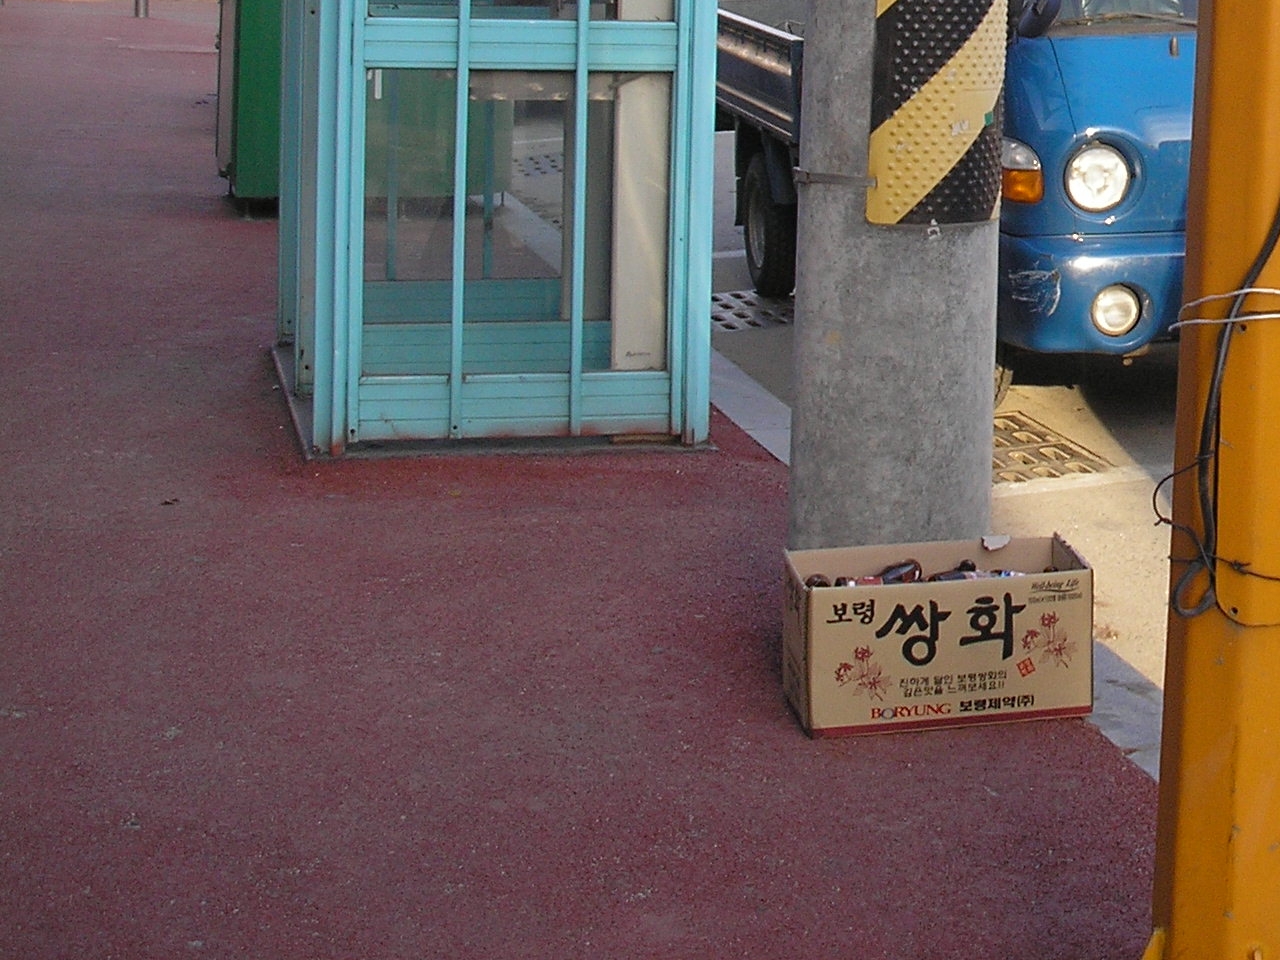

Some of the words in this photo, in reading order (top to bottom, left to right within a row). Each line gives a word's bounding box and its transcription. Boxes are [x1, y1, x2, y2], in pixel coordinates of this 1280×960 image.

[826, 598, 876, 625] 보령
[875, 592, 1026, 667] 쌍화
[871, 702, 951, 720] BORYUNG
[959, 694, 1034, 714] 보령제약(주)
